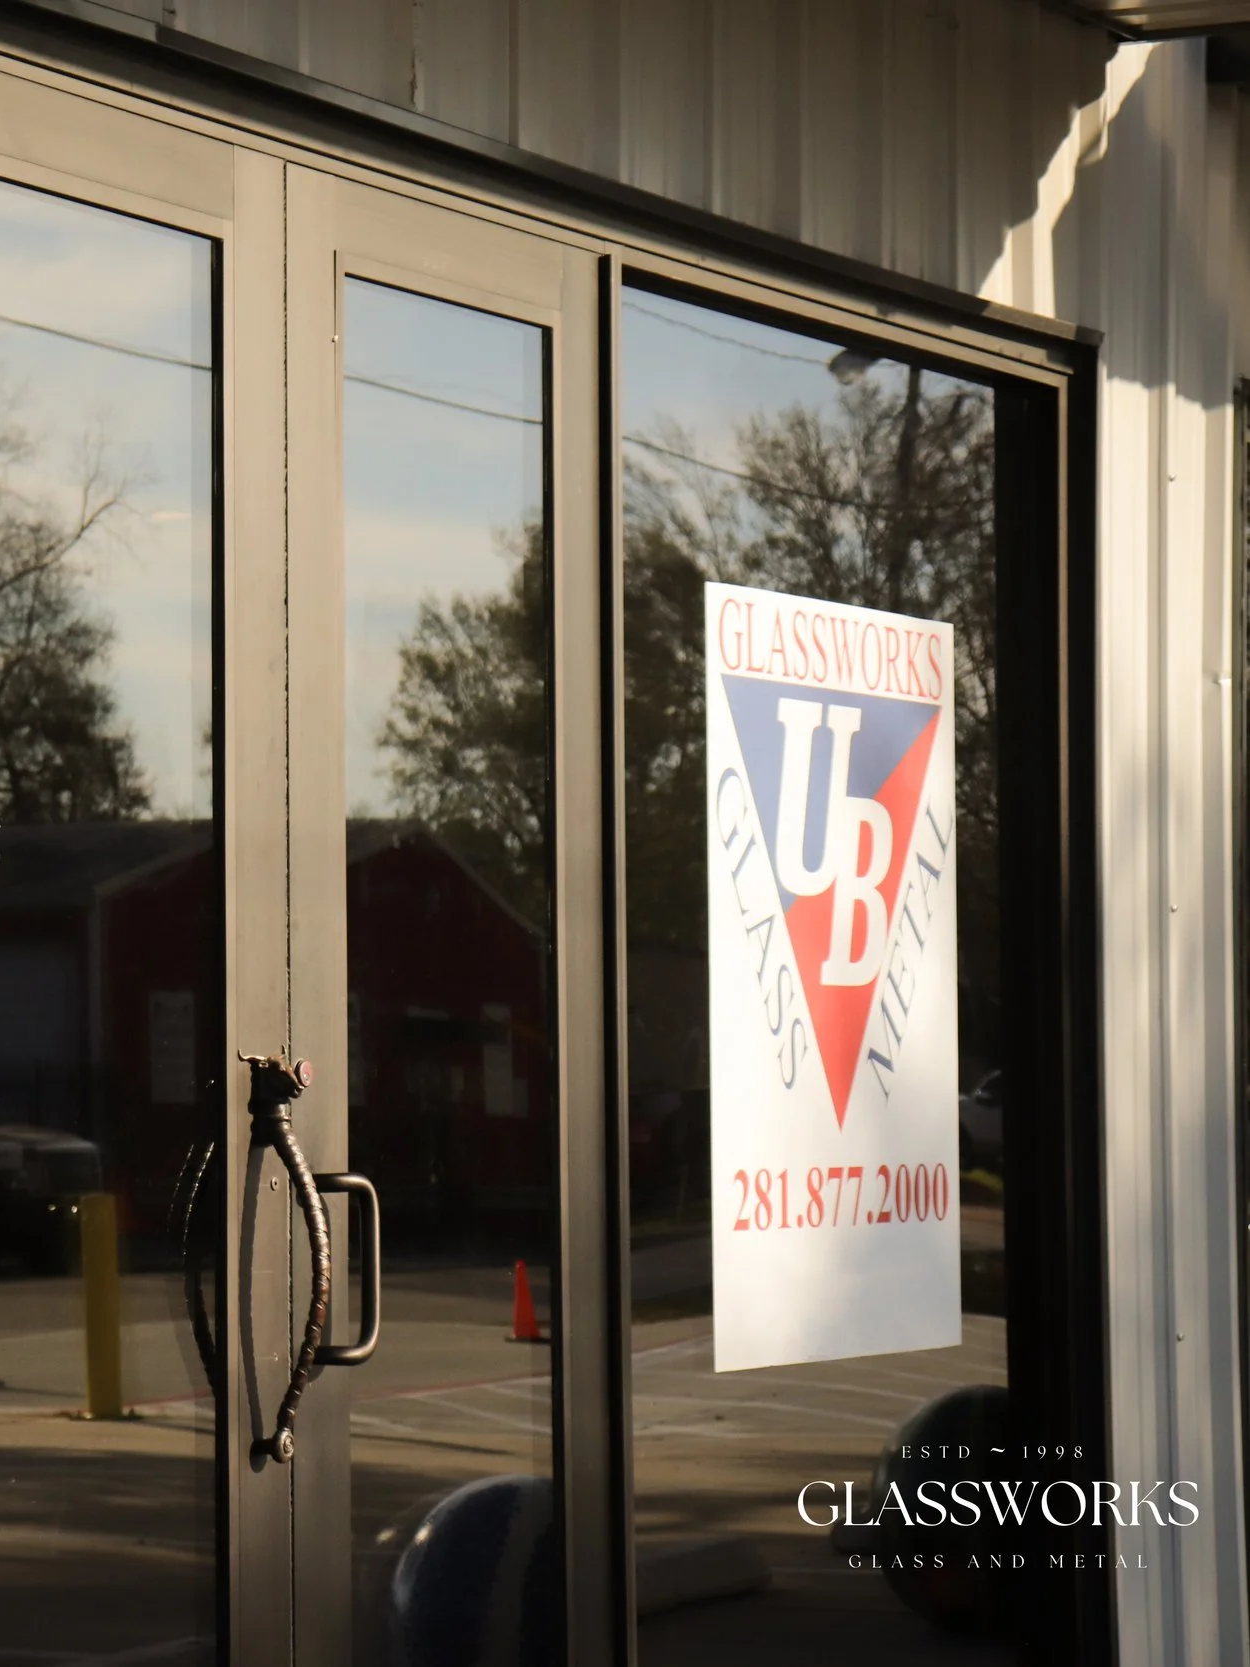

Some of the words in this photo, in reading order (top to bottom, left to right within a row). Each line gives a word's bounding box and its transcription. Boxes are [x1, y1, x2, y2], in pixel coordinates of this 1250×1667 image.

[718, 598, 943, 701] GLASSWORKS
[716, 766, 808, 1090] GLASS
[775, 697, 894, 987] UB
[867, 795, 954, 1108] METAL
[732, 1162, 949, 1232] 281.877.2000
